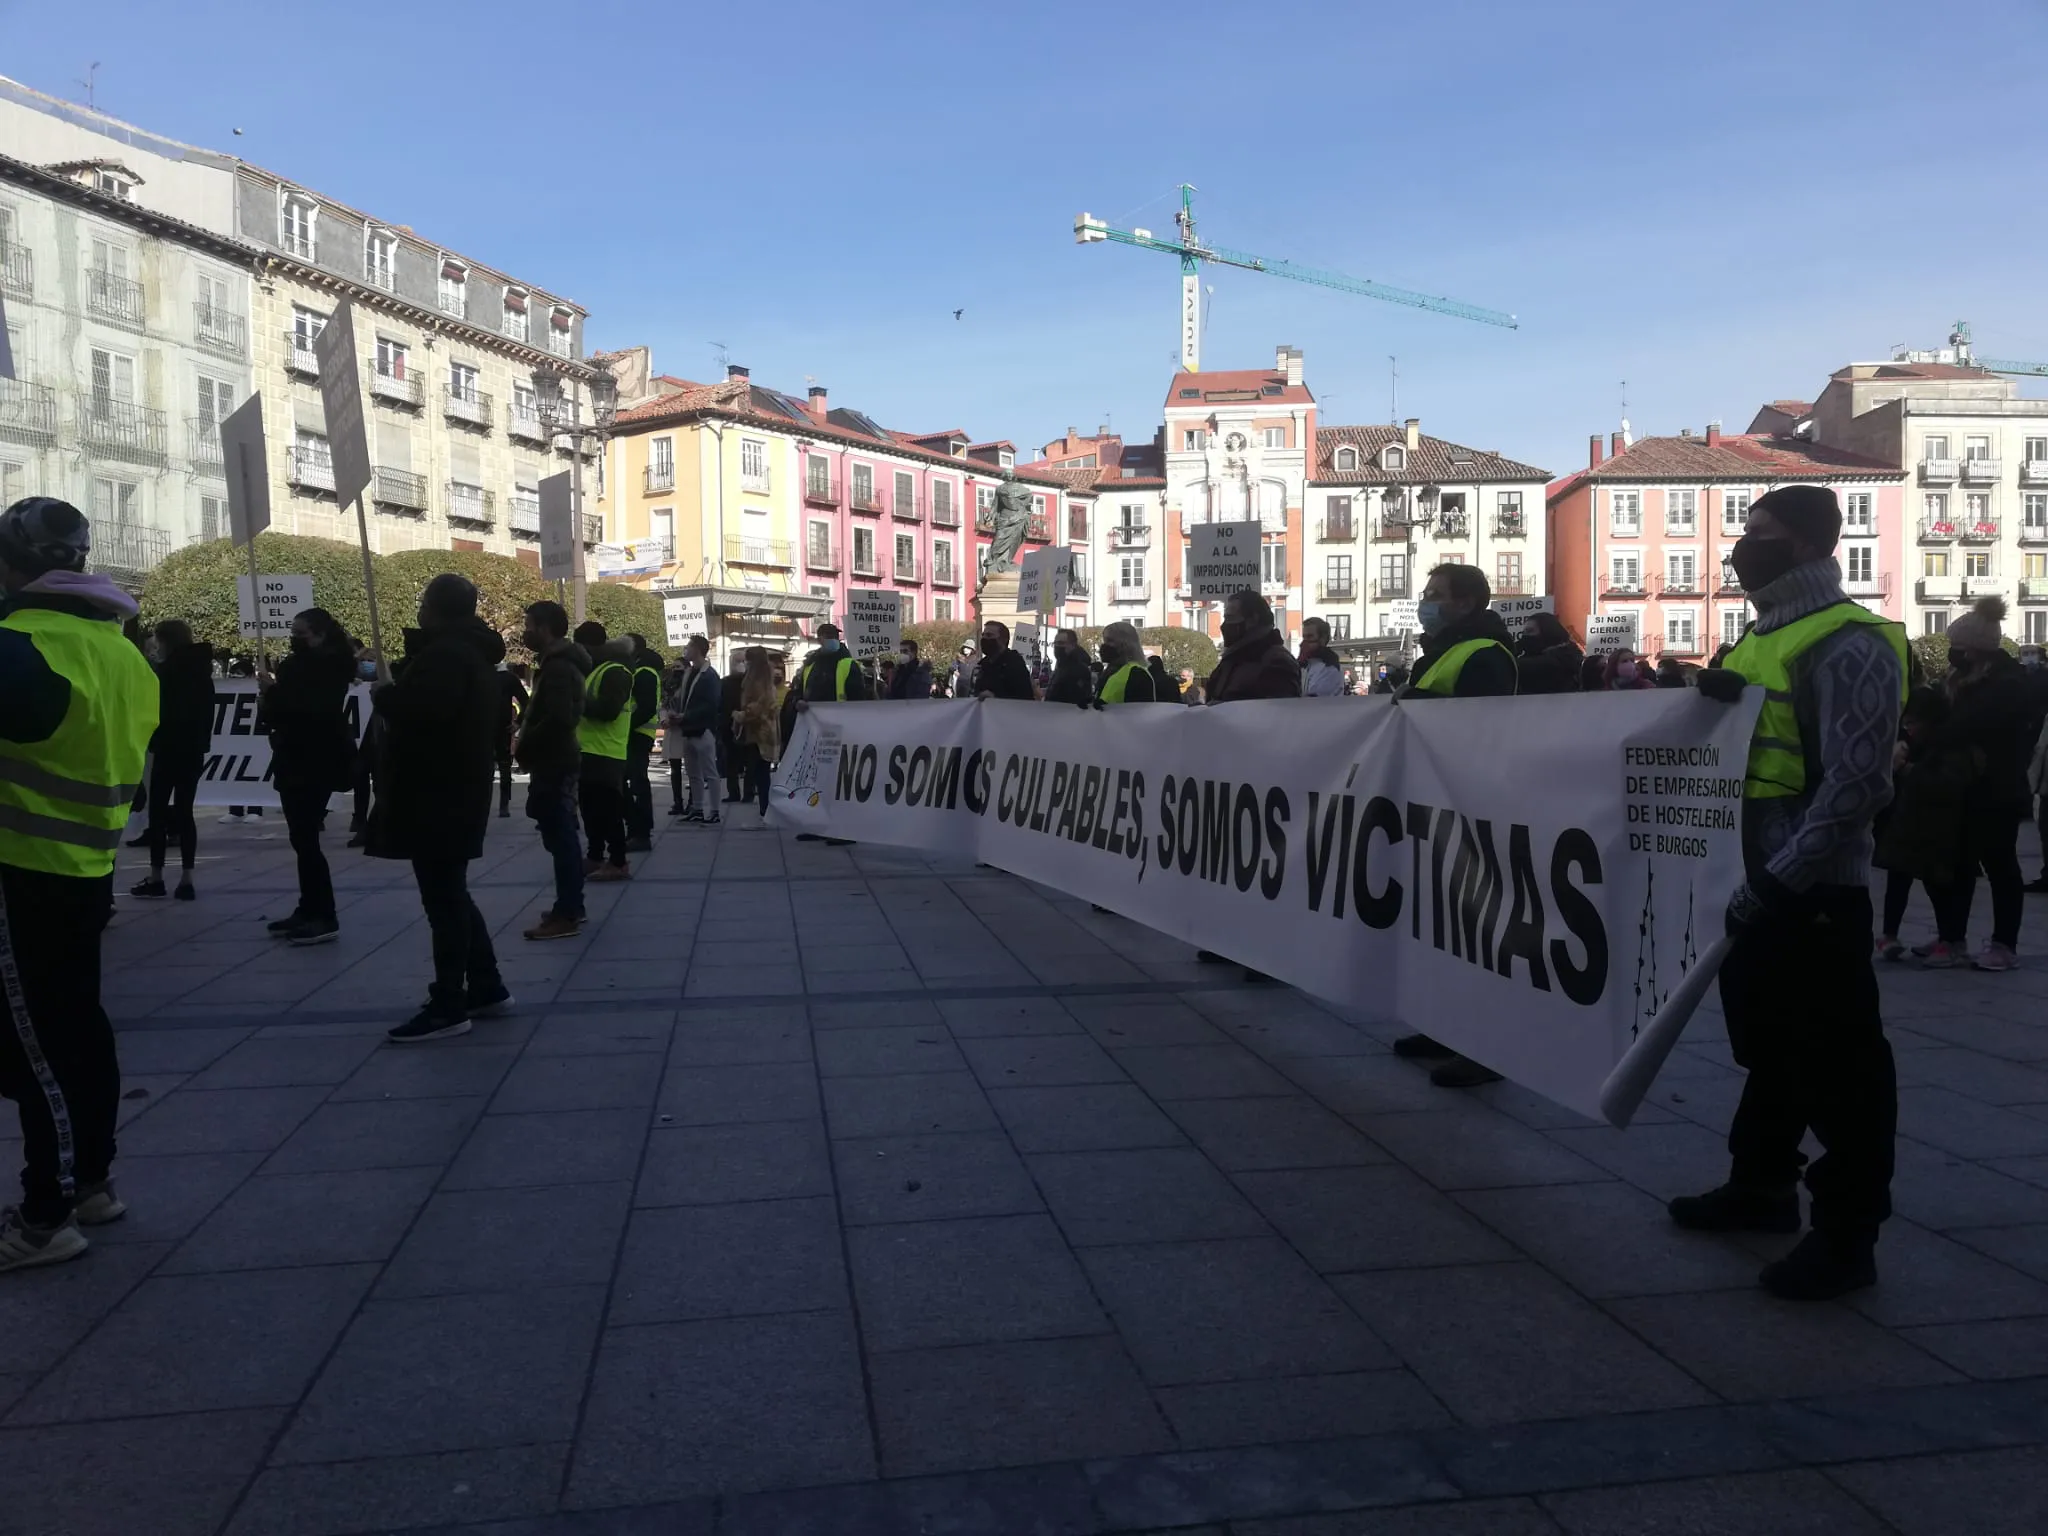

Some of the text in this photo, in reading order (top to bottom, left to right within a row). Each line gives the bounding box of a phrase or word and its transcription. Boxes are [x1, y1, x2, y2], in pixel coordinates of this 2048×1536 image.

[1217, 528, 1234, 538] NO
[1212, 546, 1238, 556] A LA
[1194, 560, 1259, 578] IMPROVISACIÓN
[266, 583, 284, 592] NO
[868, 592, 880, 600] EL
[852, 602, 896, 612] TRABAJO
[1500, 600, 1543, 612] SI NOS
[269, 608, 285, 616] EL
[680, 612, 702, 620] MUEVO
[868, 625, 880, 633] ES
[1590, 625, 1631, 634] CIERRAS
[859, 636, 890, 645] SALUD
[1626, 744, 1720, 766] FEDERACIÓN
[1626, 776, 1648, 794] DE
[1627, 805, 1735, 830] DE HOSTELERÍA
[1629, 833, 1708, 858] DE BURGOS
[836, 743, 1608, 1006] NO SOMOS CULPABLES, SOMOS VÍCTIMAS
